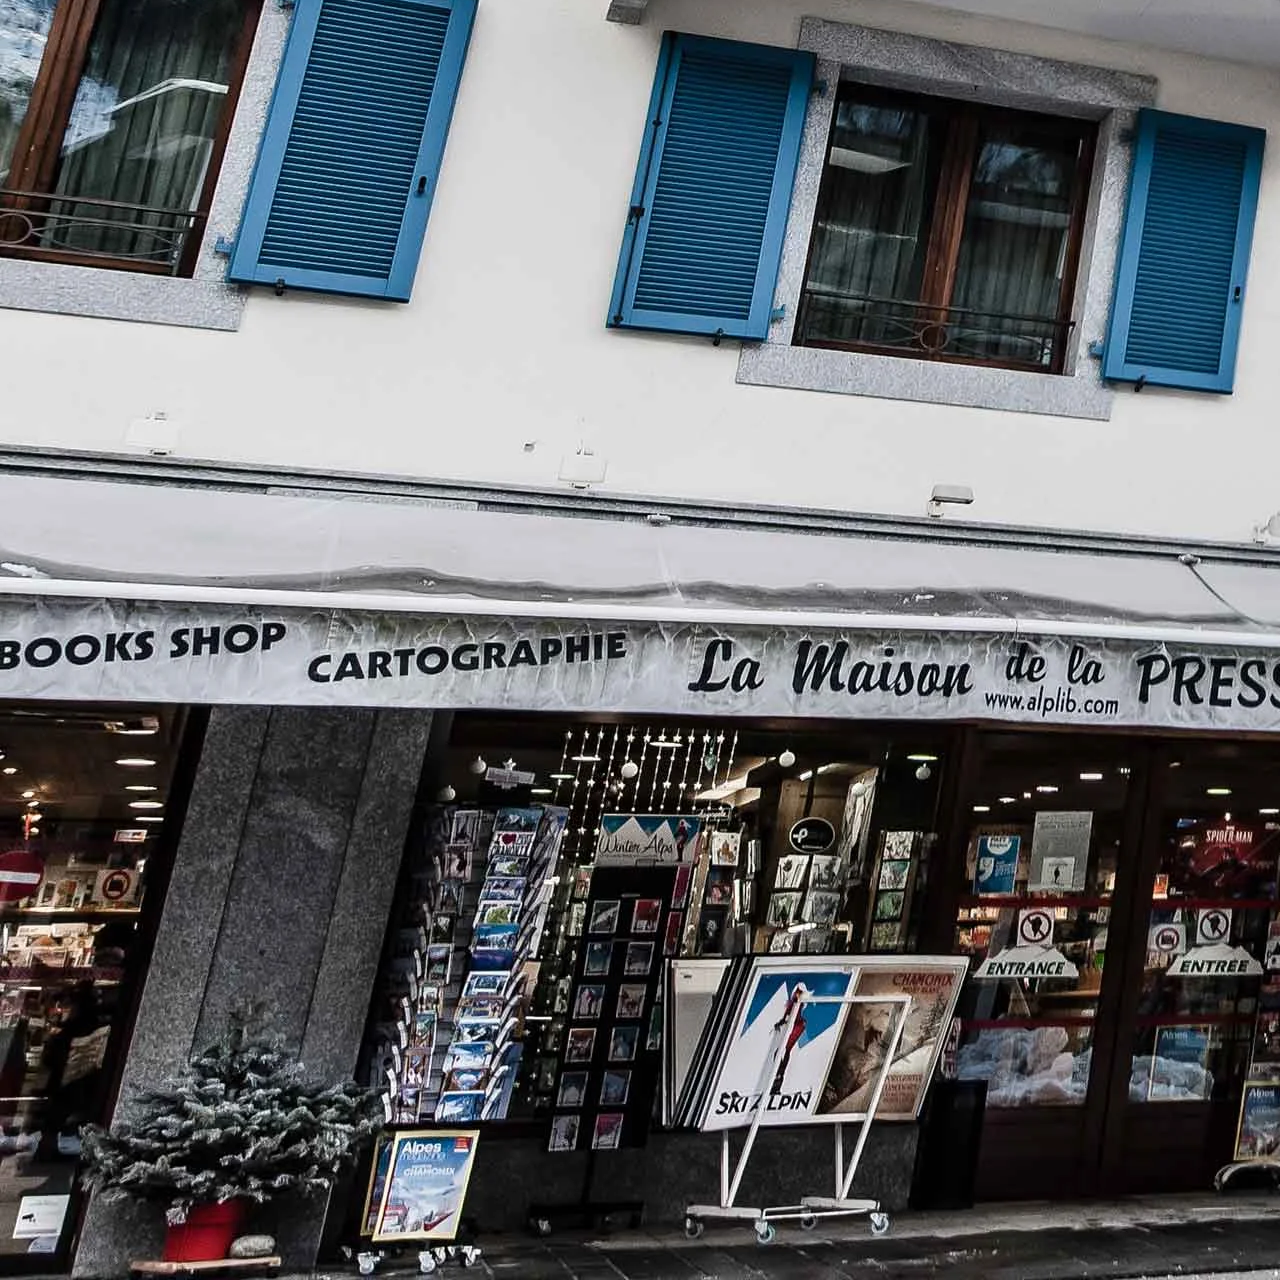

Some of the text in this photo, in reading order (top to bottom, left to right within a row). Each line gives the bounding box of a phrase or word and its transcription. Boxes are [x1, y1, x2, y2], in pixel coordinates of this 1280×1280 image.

[0, 622, 286, 670] BOOKS SHOP
[307, 632, 627, 683] CARTOGRAPHIE
[687, 638, 764, 693] La
[791, 638, 974, 697] Maison
[1006, 644, 1046, 683] de
[1067, 645, 1105, 686] la
[984, 687, 1119, 718] www.alplib.com
[599, 832, 673, 857] Winter Alps
[986, 961, 1066, 976] ENTRANCE
[715, 1090, 748, 1115] SKI
[402, 1141, 441, 1153] Alpes
